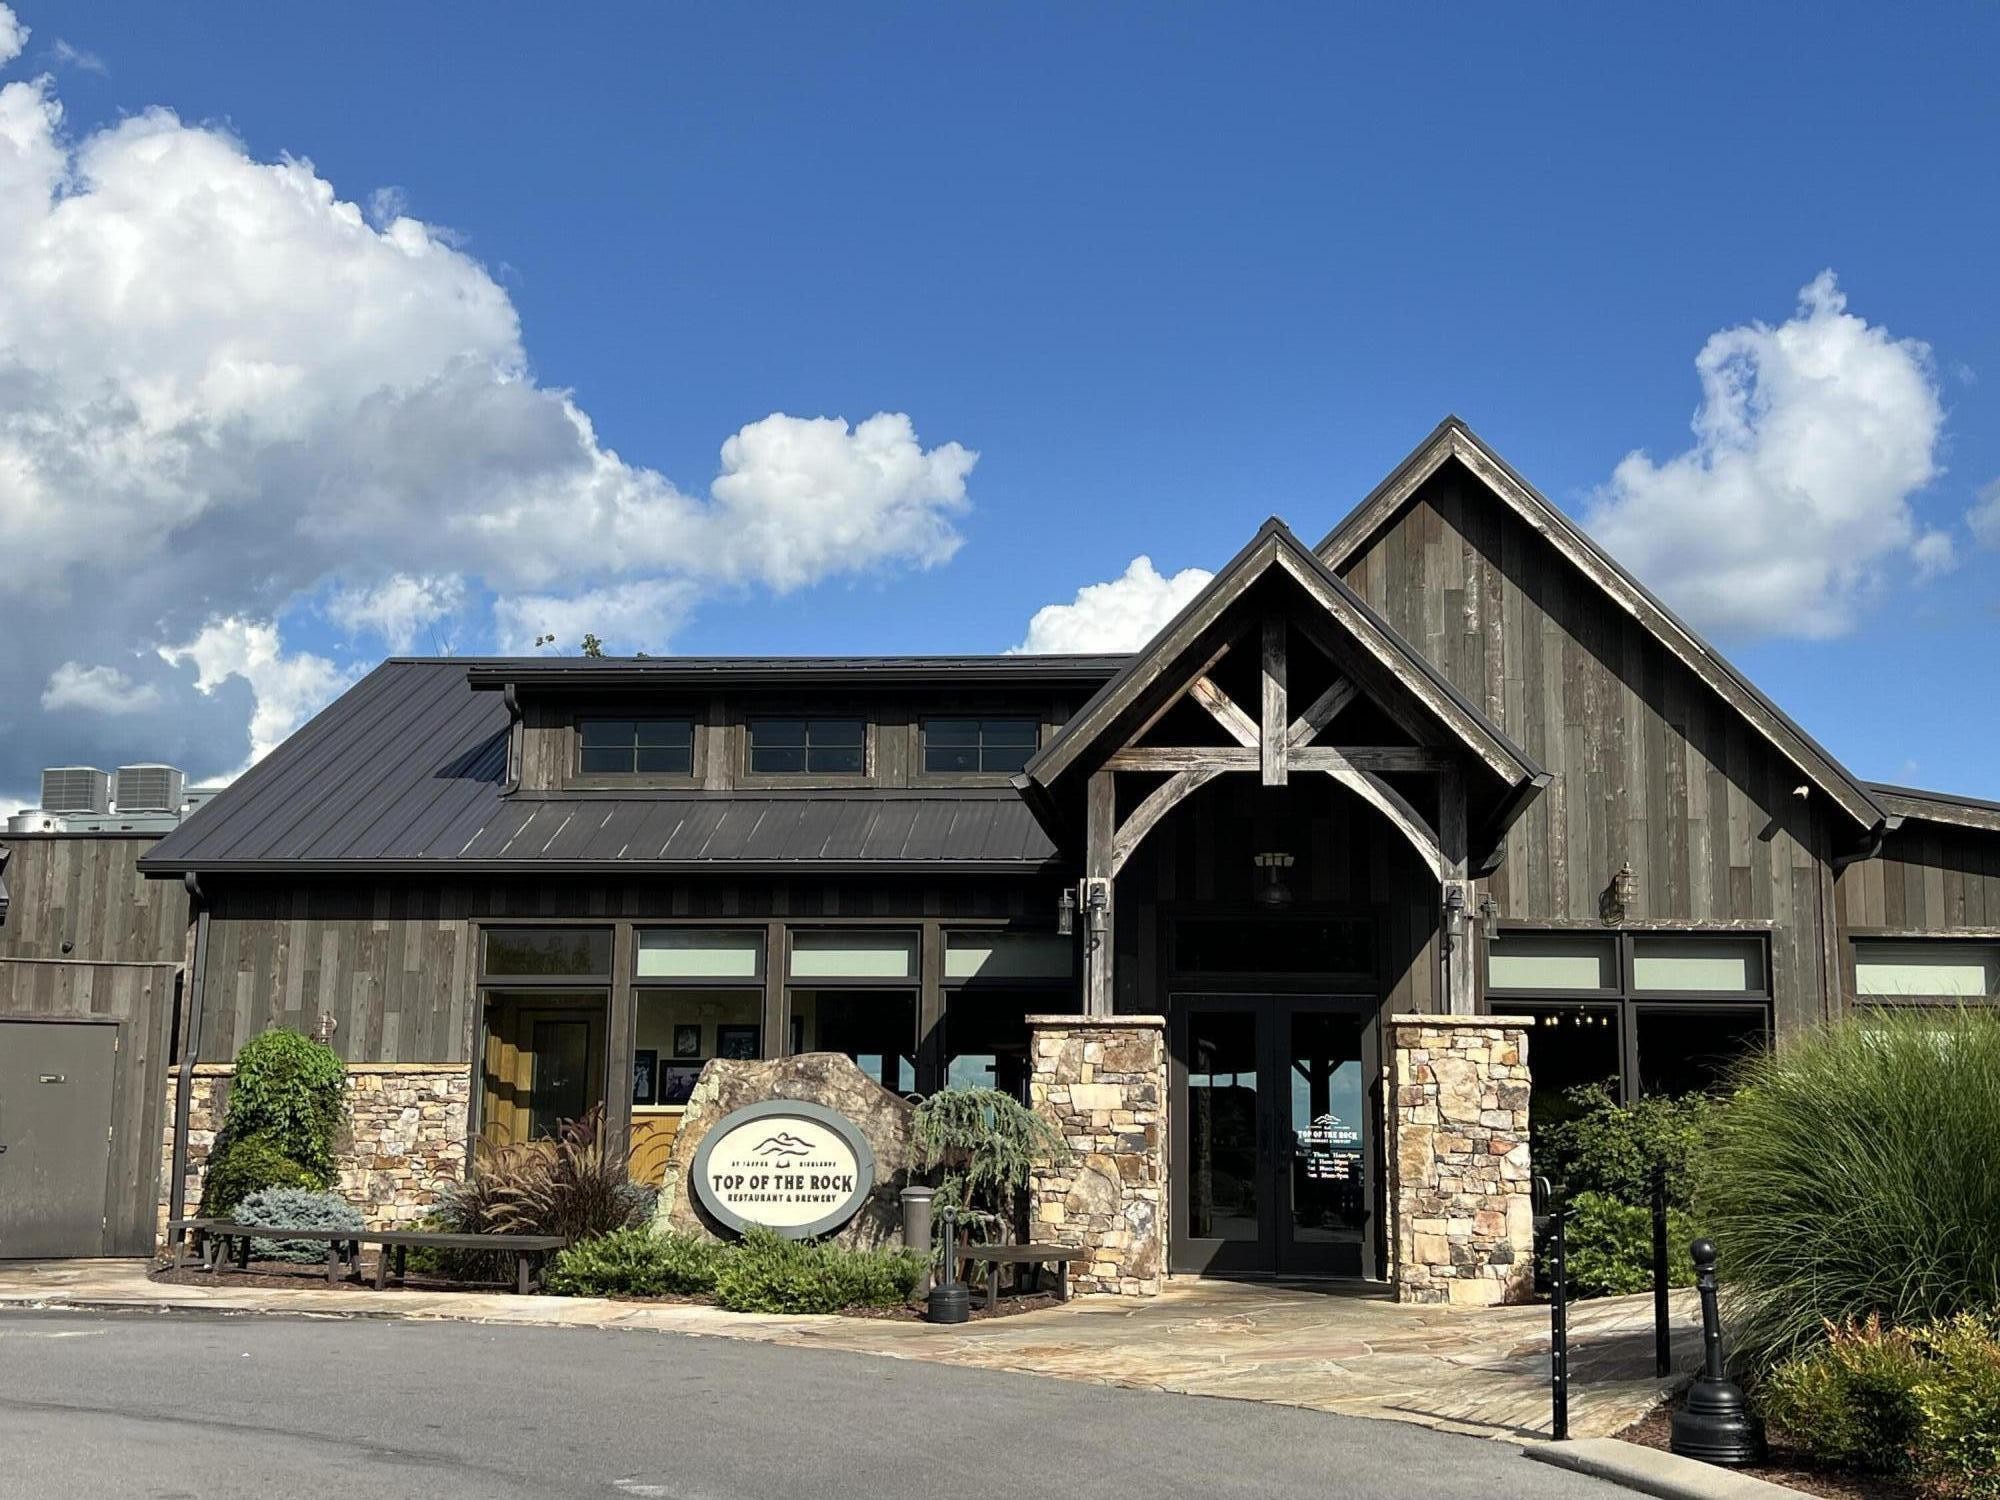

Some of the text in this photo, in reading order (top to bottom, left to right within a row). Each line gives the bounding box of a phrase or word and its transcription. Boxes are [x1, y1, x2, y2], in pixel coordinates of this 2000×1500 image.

[1297, 1130, 1312, 1139] TOP
[1323, 1131, 1338, 1139] THE
[1338, 1131, 1358, 1140] ROCK
[712, 1175, 853, 1192] TOP OF THE ROCK
[727, 1193, 837, 1203] RESTAURANT & BREWERY
